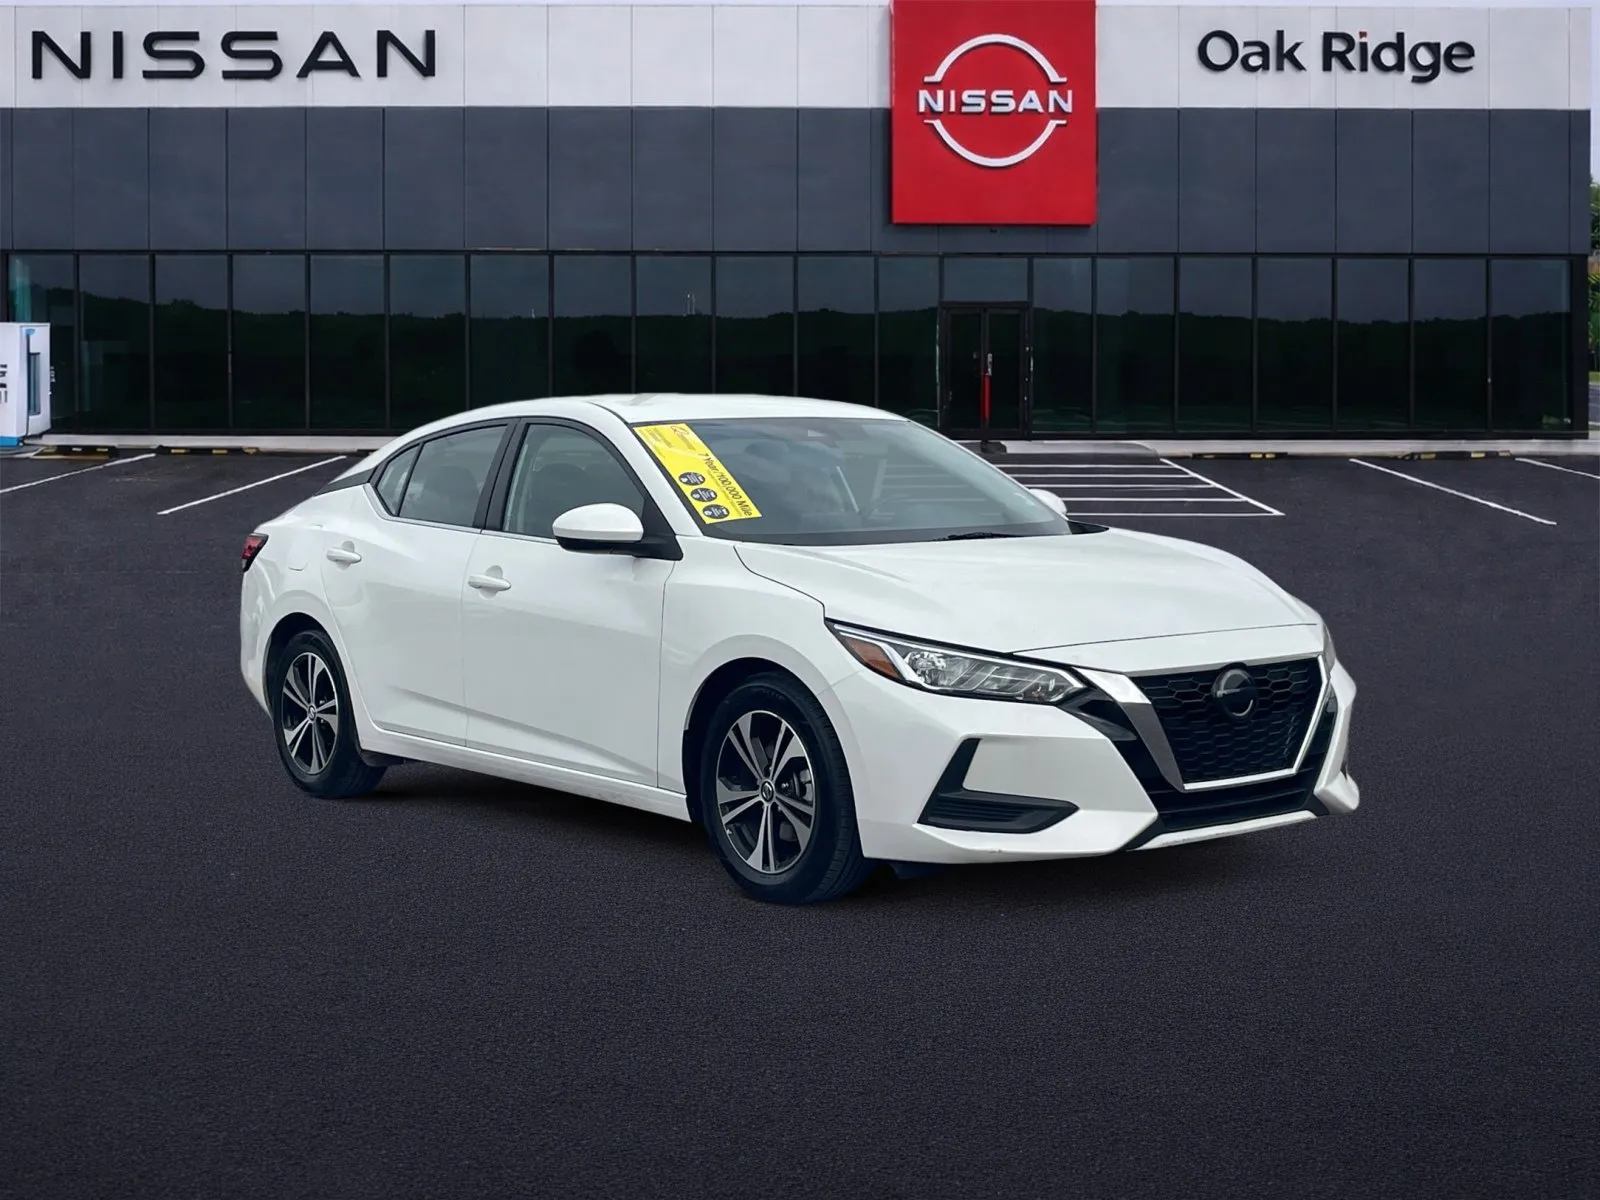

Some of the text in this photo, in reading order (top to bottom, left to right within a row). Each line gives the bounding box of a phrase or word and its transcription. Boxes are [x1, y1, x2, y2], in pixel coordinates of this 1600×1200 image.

[32, 30, 436, 81] NISSAN
[1198, 30, 1476, 85] Oak Ridge
[918, 89, 1074, 114] NISSAN
[736, 499, 752, 516] Mile
